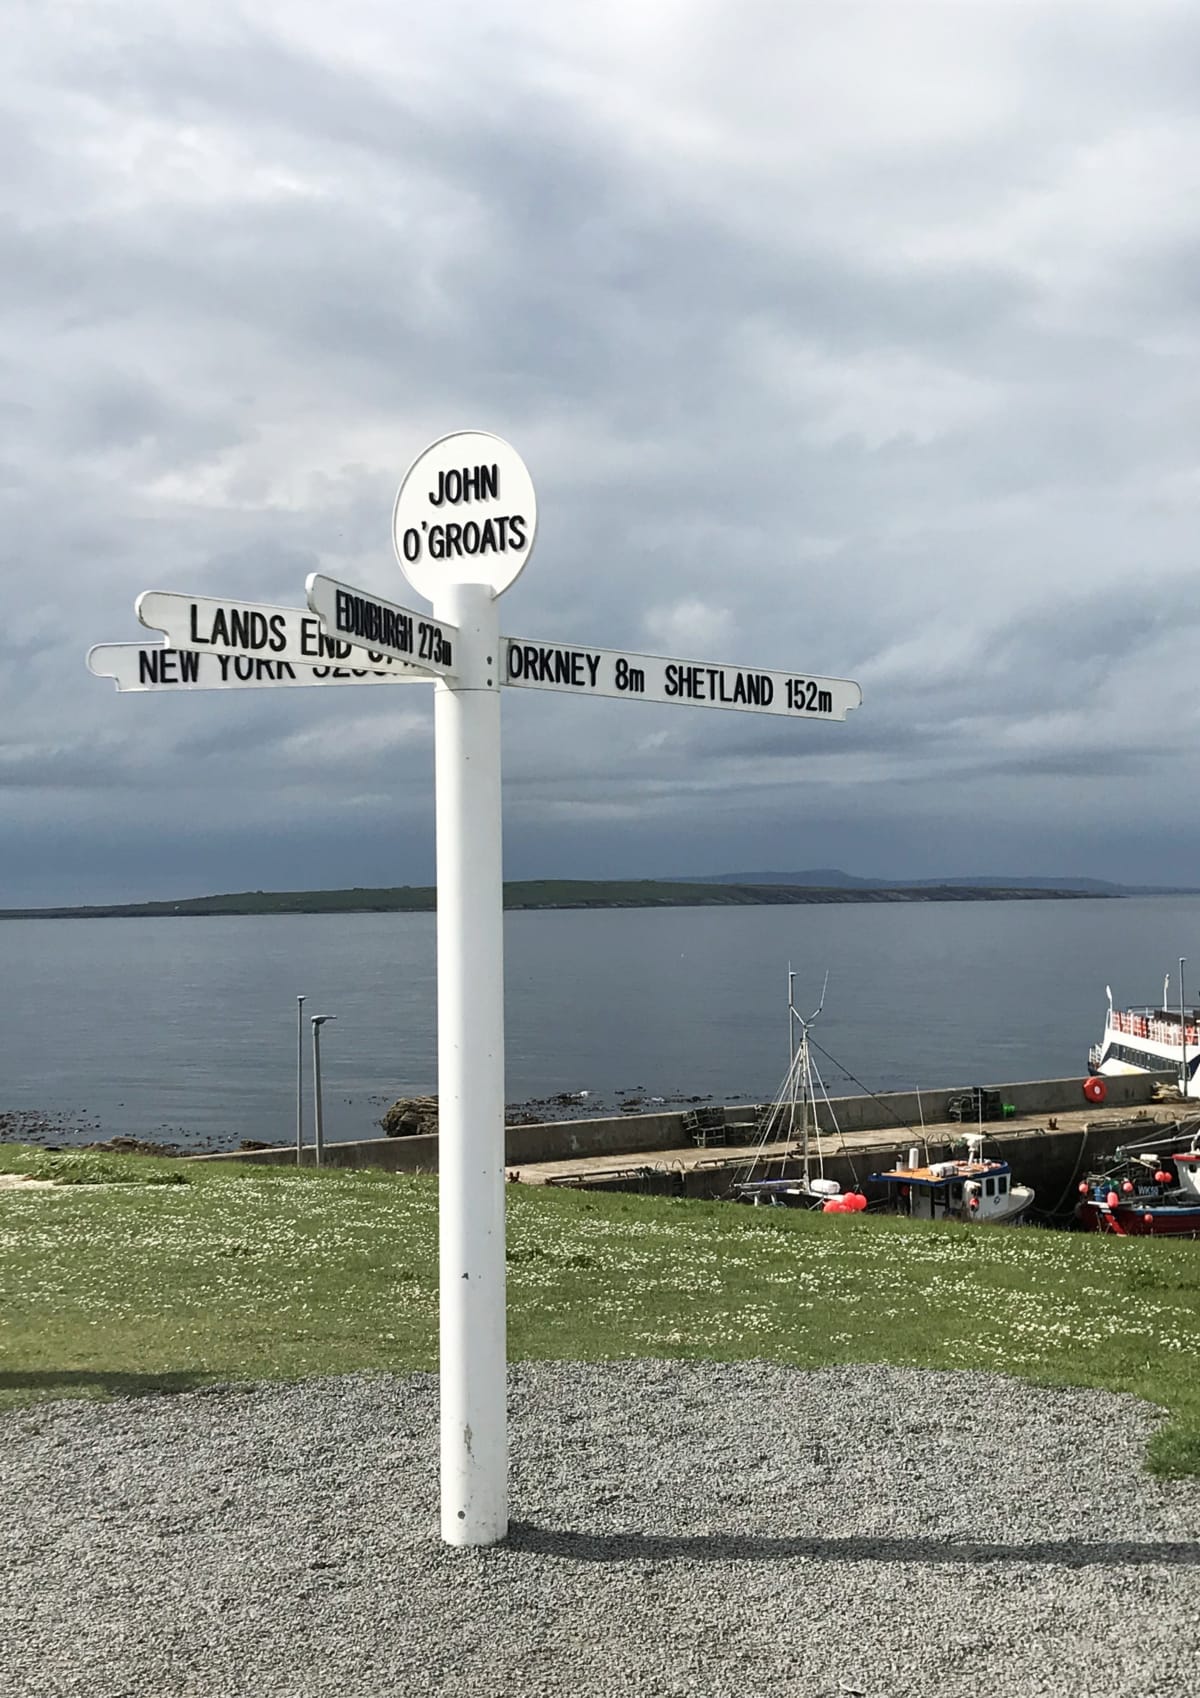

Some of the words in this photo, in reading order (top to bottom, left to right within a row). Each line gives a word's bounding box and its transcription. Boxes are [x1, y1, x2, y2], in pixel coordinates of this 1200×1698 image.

[429, 463, 498, 506] JOHN
[403, 515, 526, 561] O'GROATS
[191, 603, 287, 652] LANDS
[336, 589, 413, 653] EDINBURGH
[418, 622, 452, 666] 273m
[138, 649, 200, 683] NEW
[509, 645, 600, 687] ORKNEY
[615, 658, 645, 693] 8m
[664, 664, 774, 707] SHETLAND
[785, 678, 833, 713] 152m
